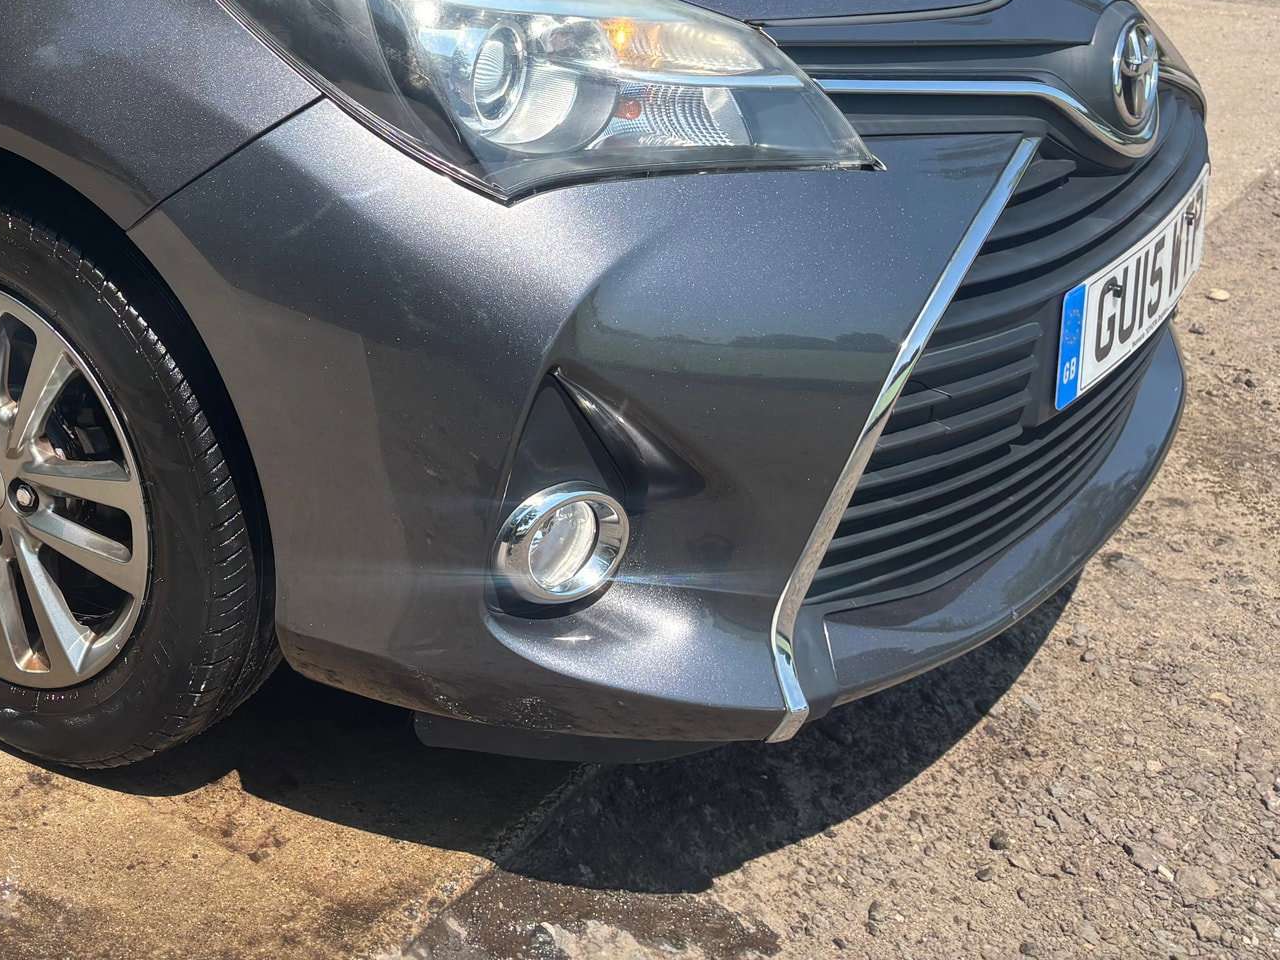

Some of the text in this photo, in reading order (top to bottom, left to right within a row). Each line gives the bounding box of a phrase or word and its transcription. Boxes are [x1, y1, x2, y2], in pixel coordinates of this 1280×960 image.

[1094, 235, 1166, 364] GU15
[1169, 183, 1204, 298] WTP
[1063, 356, 1076, 384] GB
